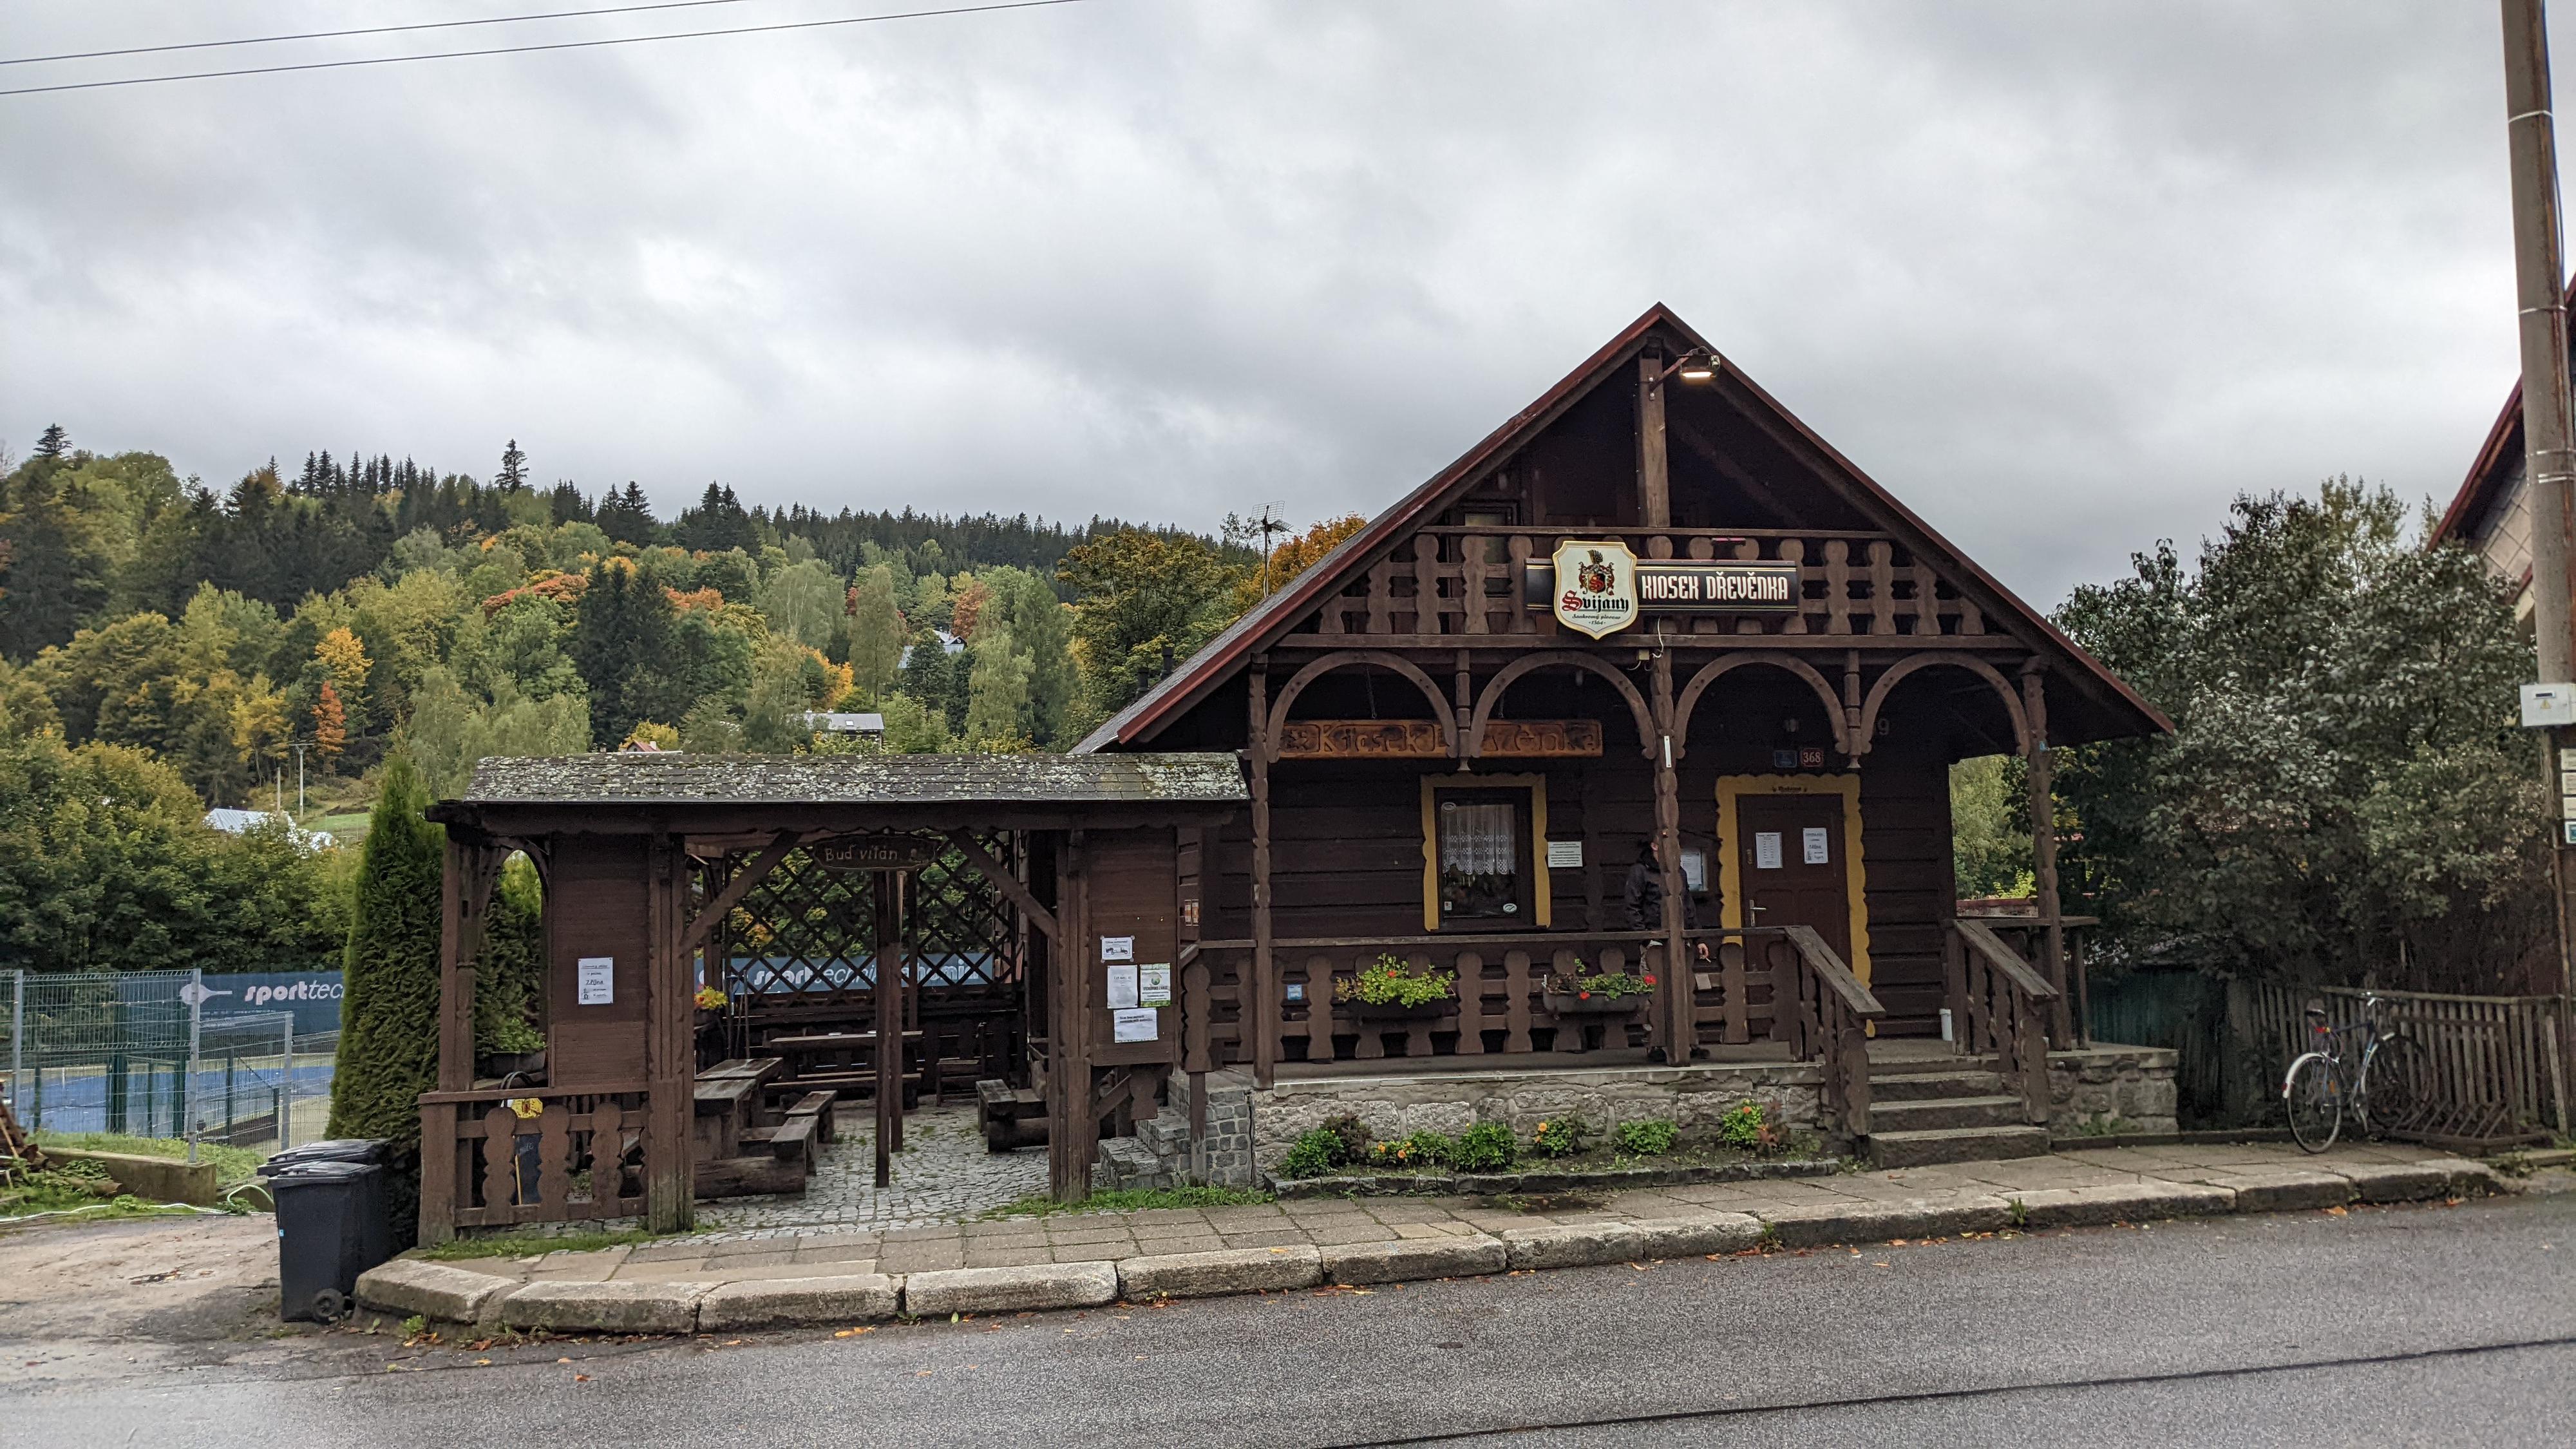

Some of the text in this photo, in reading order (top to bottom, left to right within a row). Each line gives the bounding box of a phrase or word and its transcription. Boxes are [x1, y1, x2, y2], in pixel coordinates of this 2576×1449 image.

[1642, 571, 1788, 601] KIOSEK DŘEVĚNKA
[1561, 589, 1629, 613] Svijany
[1803, 752, 1822, 763] 368
[245, 980, 345, 1005] sporttec
